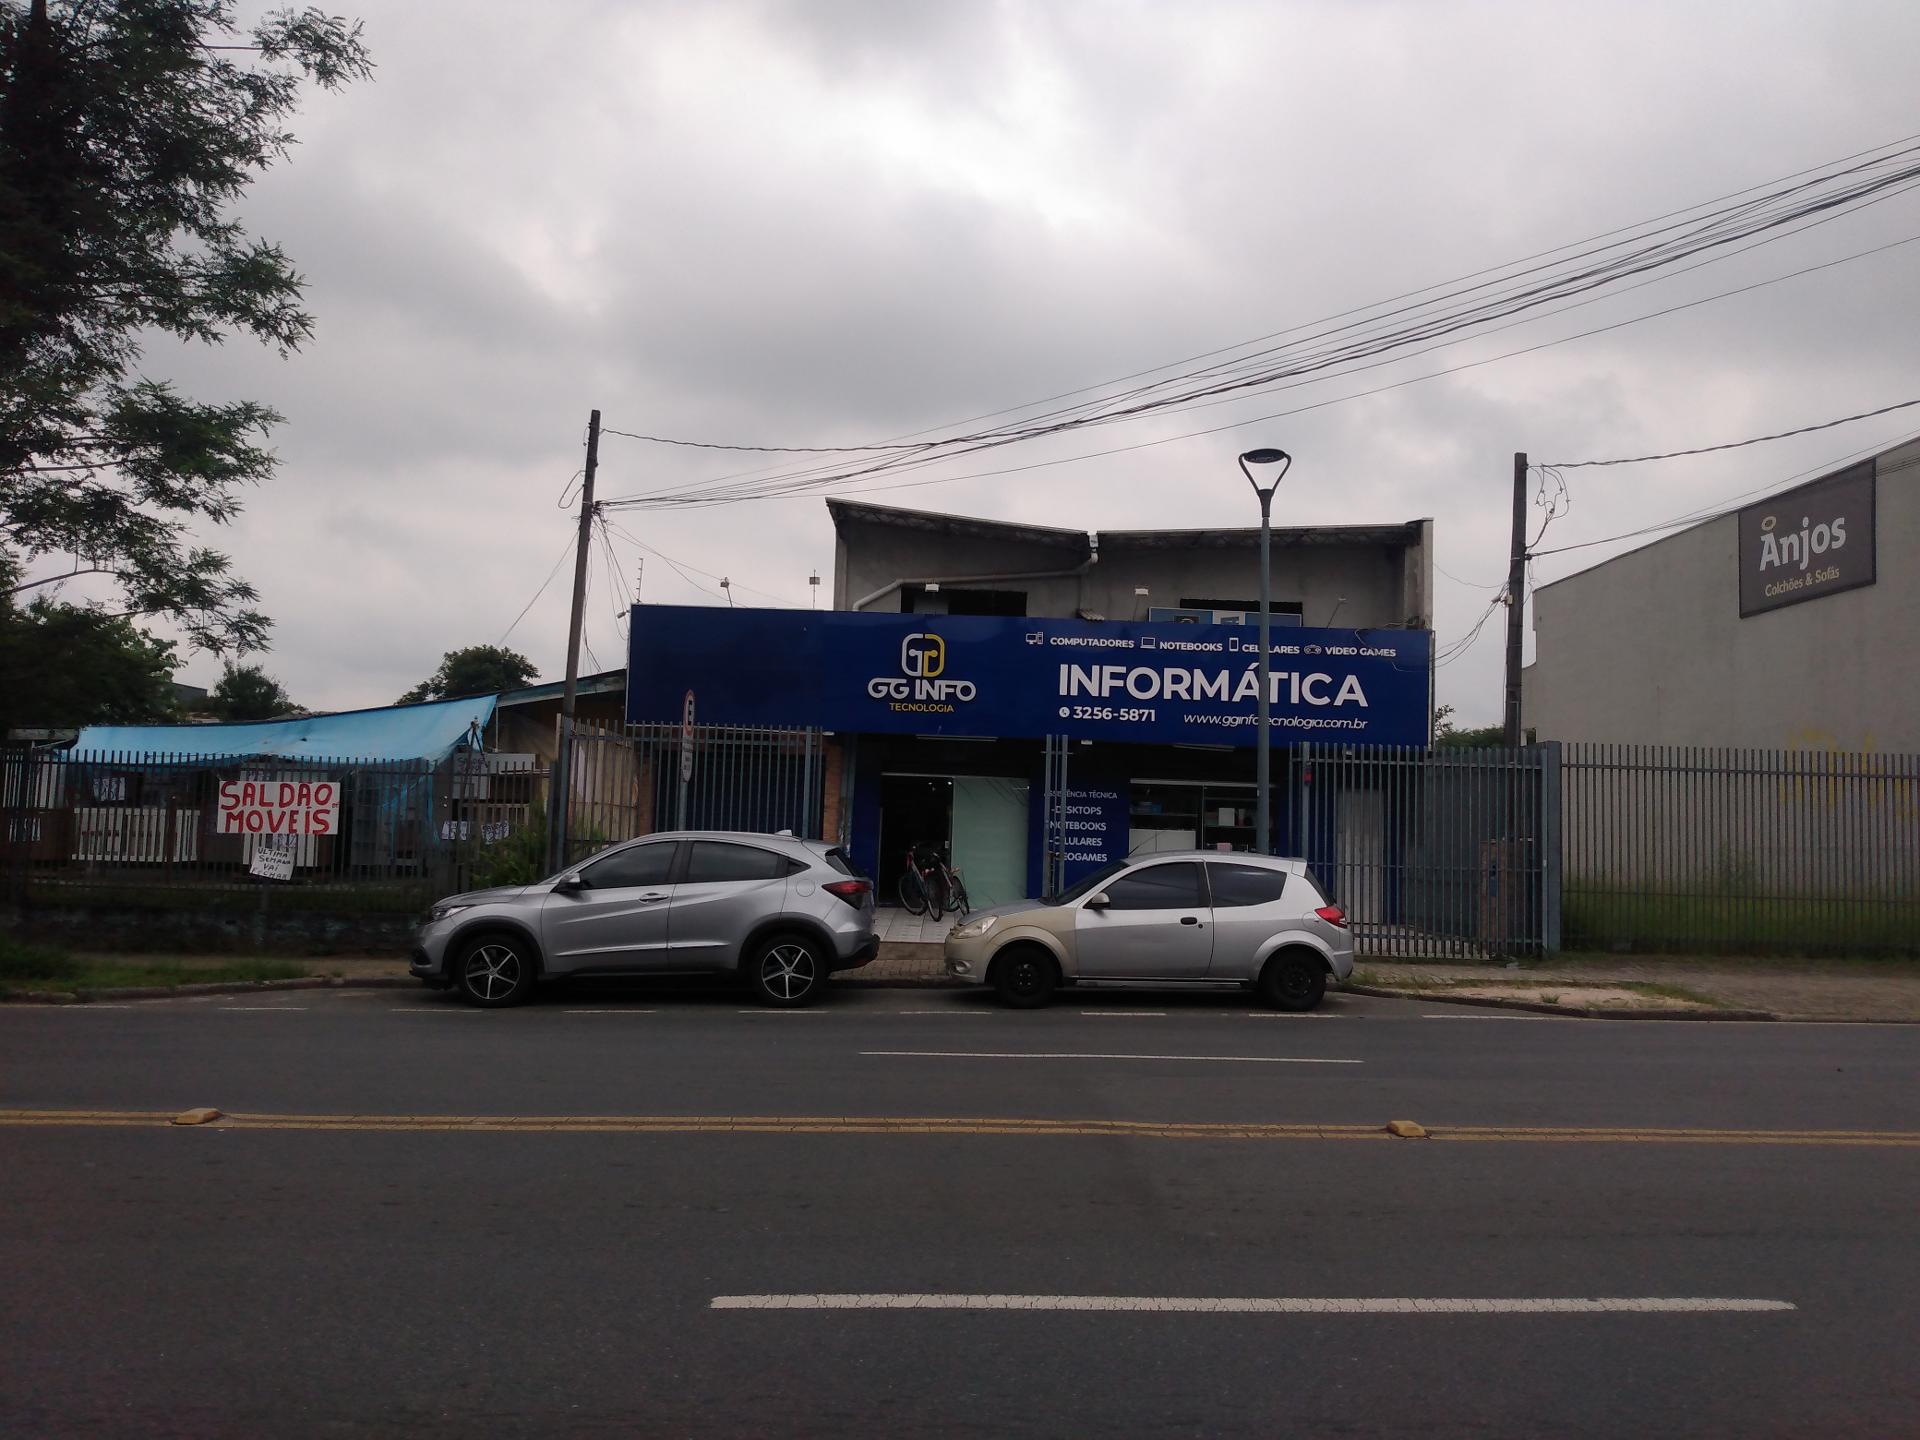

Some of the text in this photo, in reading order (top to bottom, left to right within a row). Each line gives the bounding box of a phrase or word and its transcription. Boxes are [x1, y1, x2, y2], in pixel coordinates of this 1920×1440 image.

[1759, 516, 1847, 571] Anjos
[1765, 566, 1840, 597] Colchões & Sofás
[1050, 636, 1135, 649] COMPUTADORES
[1159, 640, 1223, 652] NOTEBOOKS
[1241, 643, 1300, 655] CELLARES
[1359, 647, 1397, 657] GAMES
[867, 677, 977, 702] GG INFO
[1059, 662, 1369, 708] INFORMÁTICA
[889, 702, 955, 713] TECNOLOGIA
[1073, 706, 1156, 722] 3256-5871
[1183, 713, 1369, 730] www.gginfoecnologia.com.br
[1088, 790, 1118, 799] TÉCNICA
[1050, 805, 1102, 816] -DSKTOPS
[1049, 836, 1102, 847] -CLULARES
